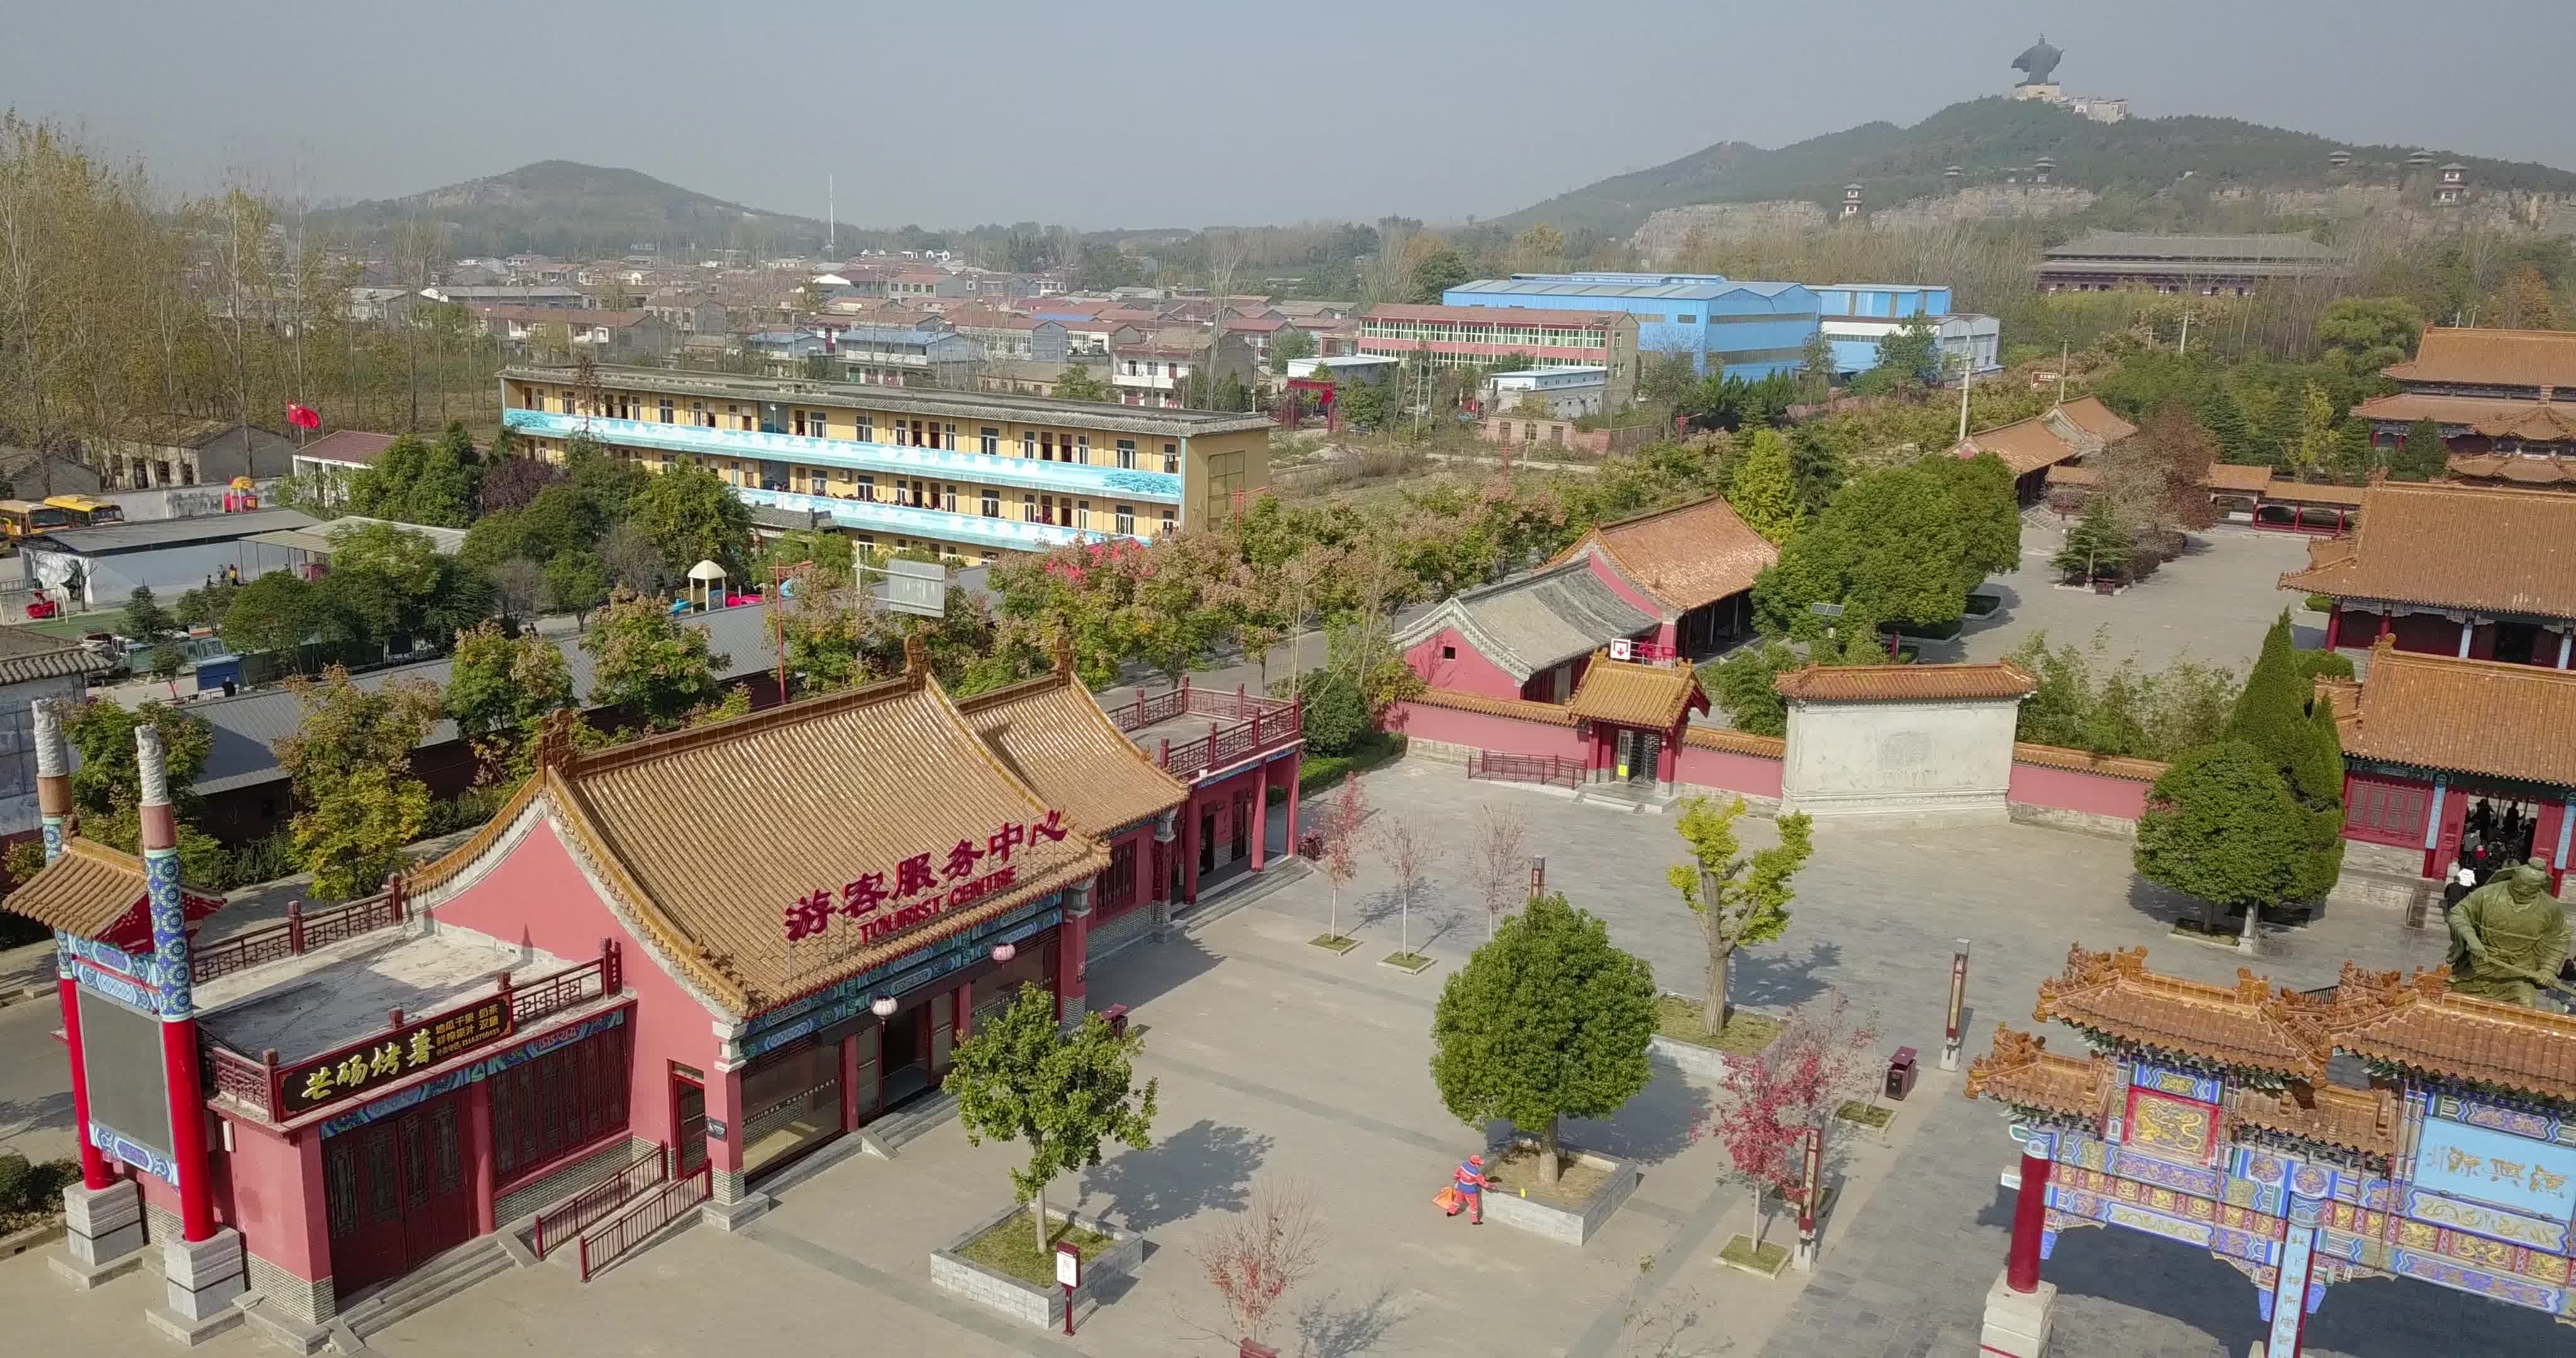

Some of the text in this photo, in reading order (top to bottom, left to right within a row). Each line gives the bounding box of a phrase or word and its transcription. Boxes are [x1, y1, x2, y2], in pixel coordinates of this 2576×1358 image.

[785, 810, 1067, 941] 游客服务中心
[859, 865, 1017, 942] TOURIST CENTRE
[301, 1029, 435, 1100] 芒砀烤薯
